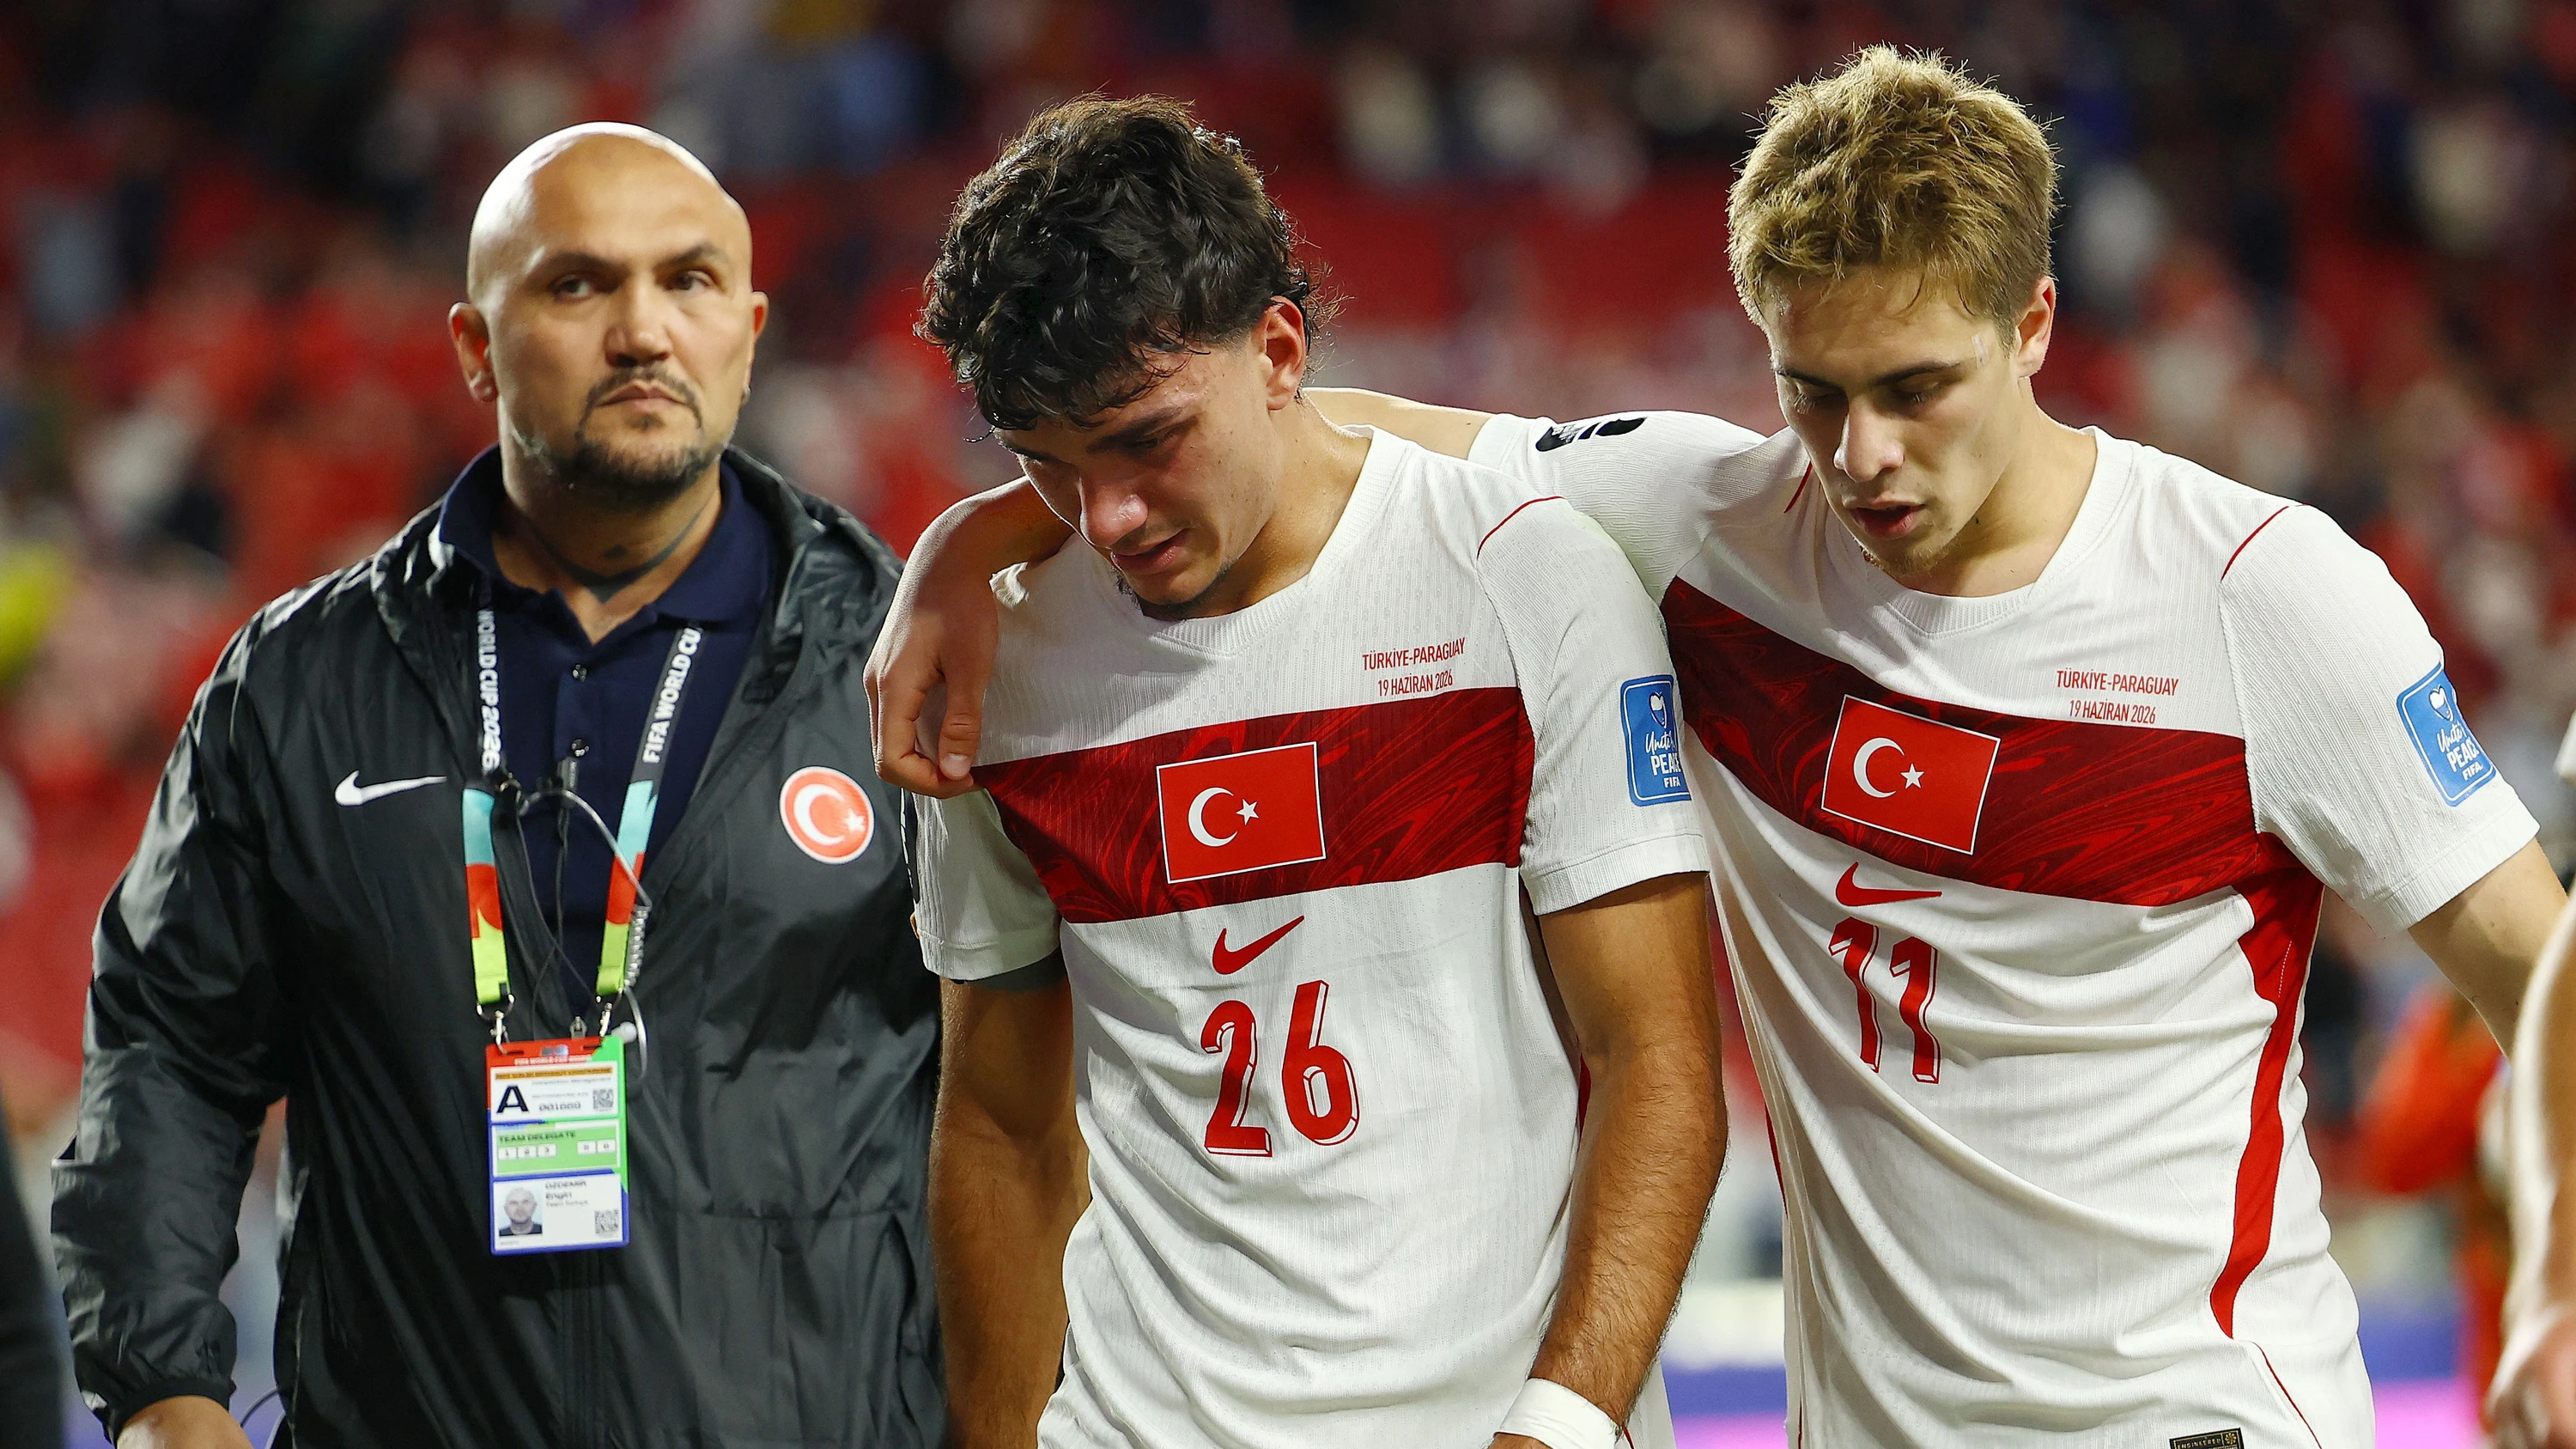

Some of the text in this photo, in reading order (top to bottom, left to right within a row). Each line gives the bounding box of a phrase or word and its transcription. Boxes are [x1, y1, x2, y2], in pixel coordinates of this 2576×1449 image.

[1363, 636, 1467, 671] TÜRKİYE-PARAGUAY
[479, 669, 499, 706] CUP
[642, 627, 702, 764] FIFA WORLD CU
[1378, 669, 1453, 697] 19 HAZİRAN 2026
[2057, 667, 2179, 697] TÜRKİYE-PARAGUAY
[2069, 698, 2156, 724] 19 HAZİRAN 2026
[481, 705, 501, 771] 2026
[2446, 736, 2480, 772] PEAC
[1663, 776, 1680, 788] FIFA
[2462, 761, 2482, 781] FIFA
[1828, 916, 1941, 1084] 11
[1200, 979, 1359, 1157] 26
[496, 1085, 529, 1113] A
[2178, 1438, 2221, 1449] ENGINEERED
